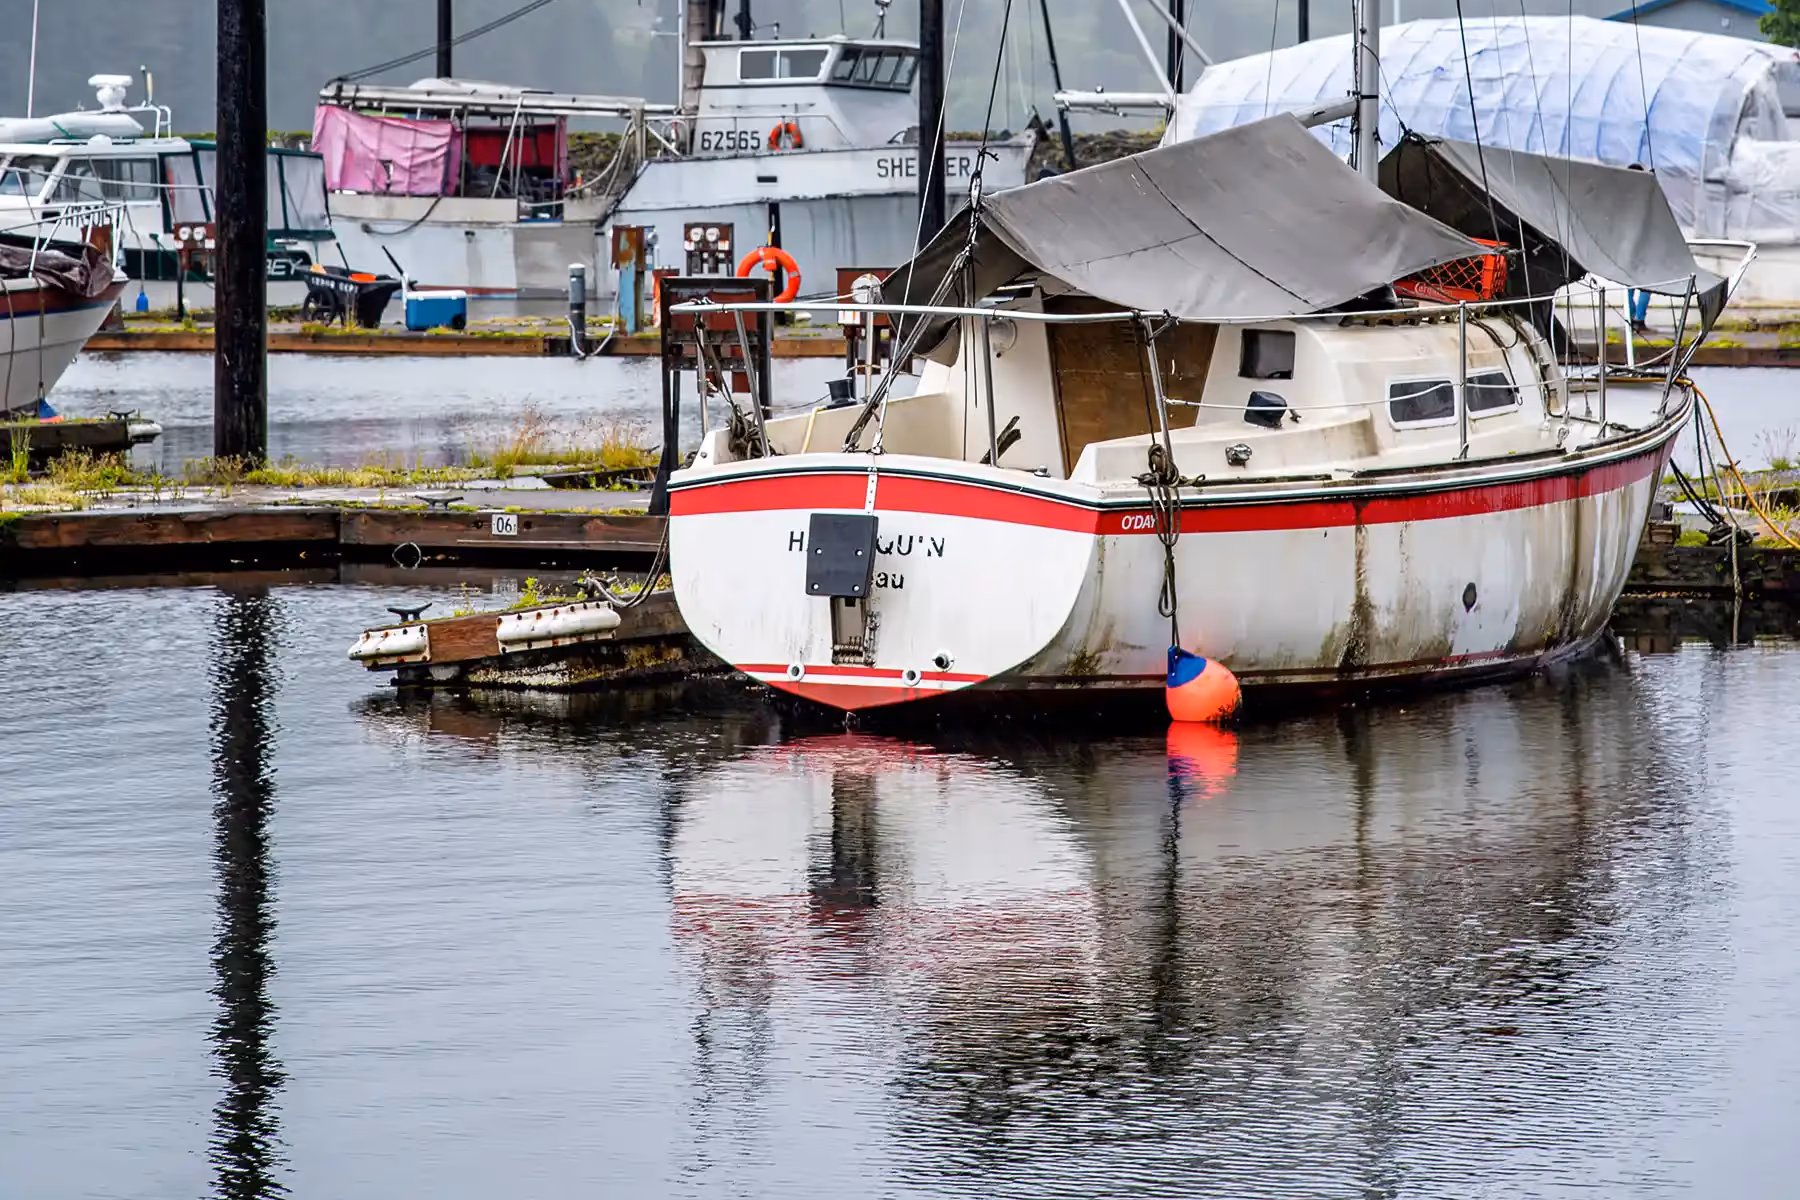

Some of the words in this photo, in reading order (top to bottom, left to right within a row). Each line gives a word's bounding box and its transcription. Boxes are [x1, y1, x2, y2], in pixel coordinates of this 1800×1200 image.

[701, 130, 761, 151] 62565
[876, 157, 970, 178] SHEER
[496, 516, 512, 533] 06
